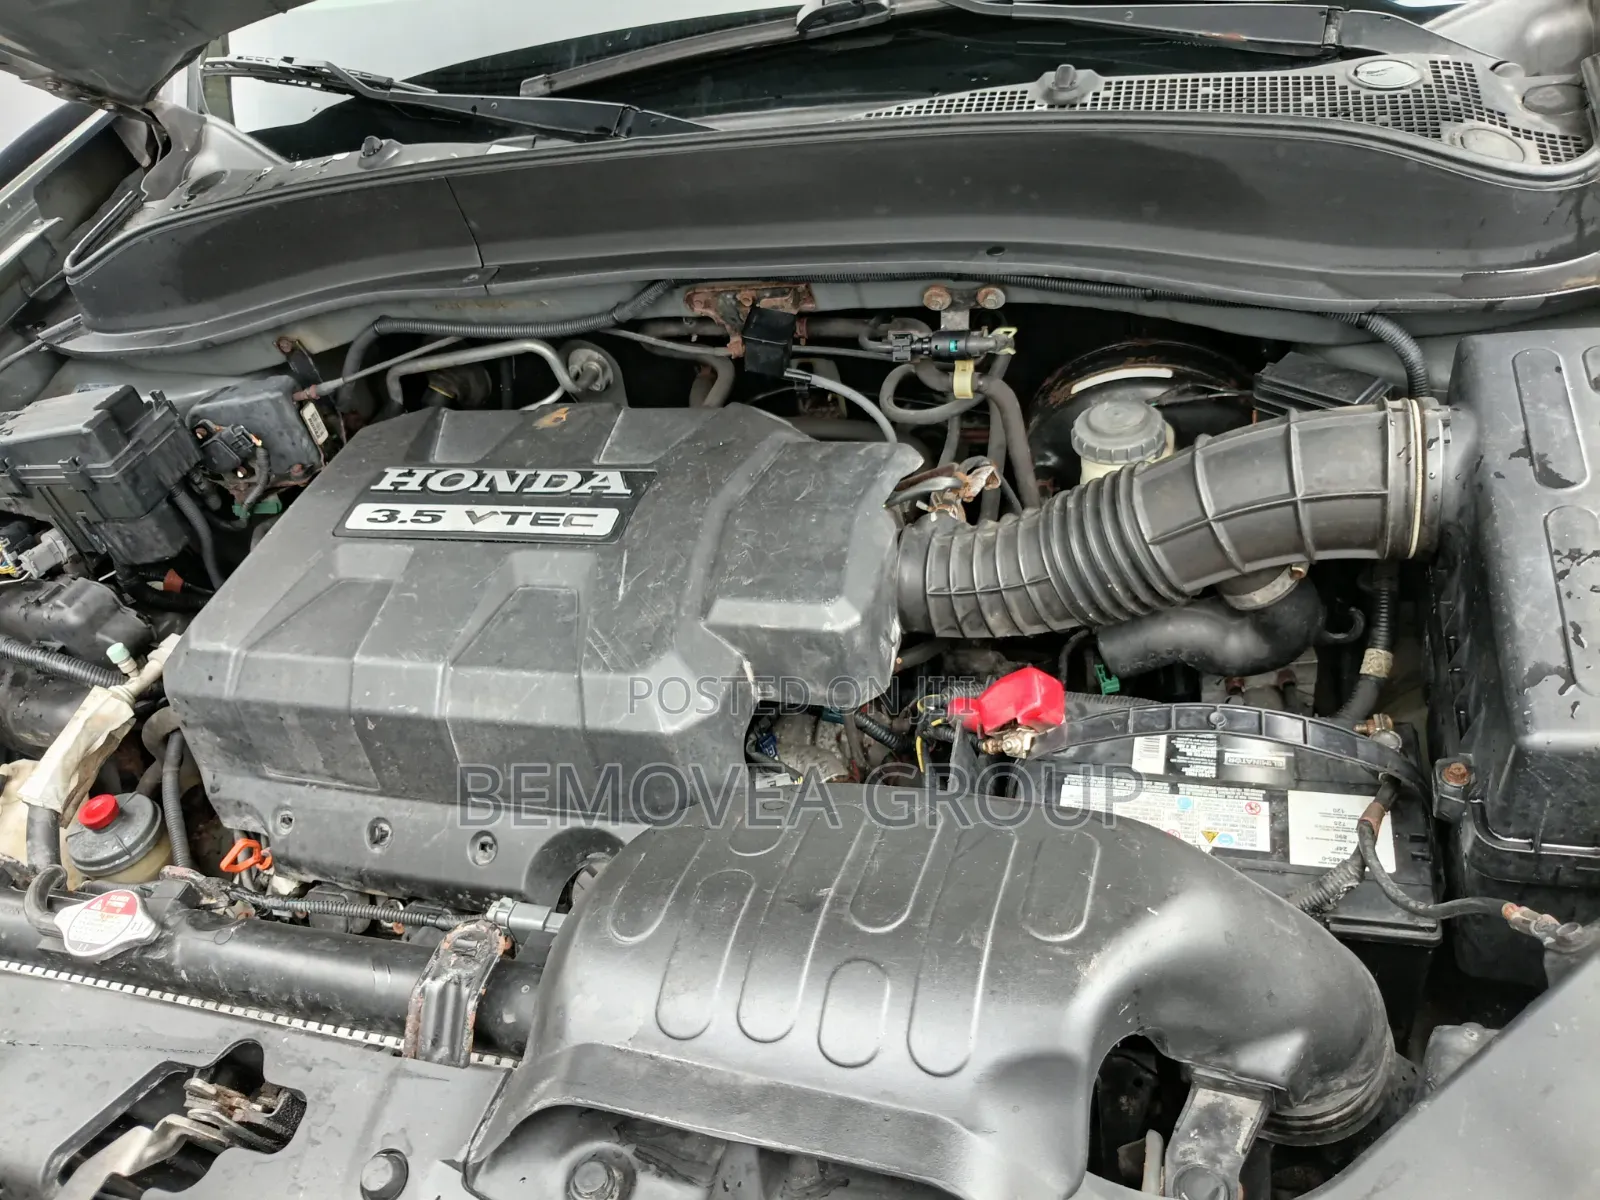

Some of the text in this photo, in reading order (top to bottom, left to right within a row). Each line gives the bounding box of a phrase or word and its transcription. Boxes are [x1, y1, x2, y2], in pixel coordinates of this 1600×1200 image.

[370, 469, 633, 496] HONDA
[366, 509, 599, 528] 3.5 VTEC
[1227, 756, 1284, 768] ELIMINATOR
